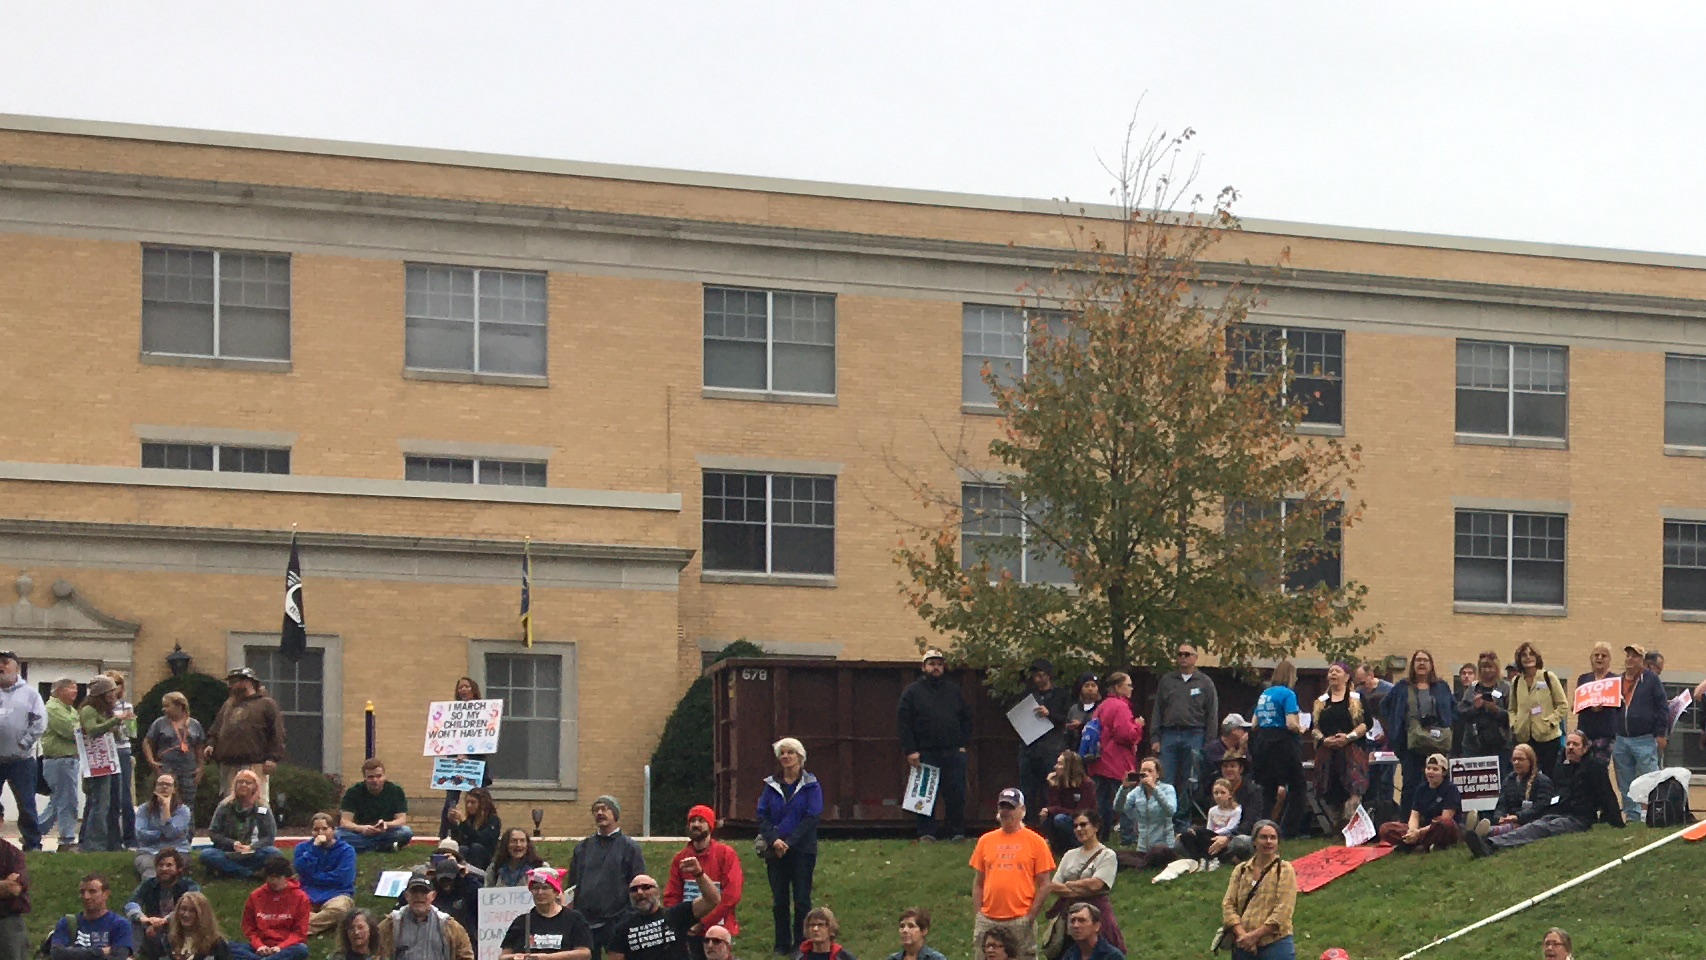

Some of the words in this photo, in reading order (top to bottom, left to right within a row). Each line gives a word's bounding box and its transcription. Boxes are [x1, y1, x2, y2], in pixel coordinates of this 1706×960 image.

[742, 668, 767, 680] 678
[1579, 680, 1614, 697] STOP
[454, 702, 487, 711] MARCH
[451, 711, 463, 720] SO
[466, 711, 480, 719] MY
[443, 720, 488, 729] CHILDREN
[460, 729, 482, 738] HAVE
[485, 728, 496, 737] TO
